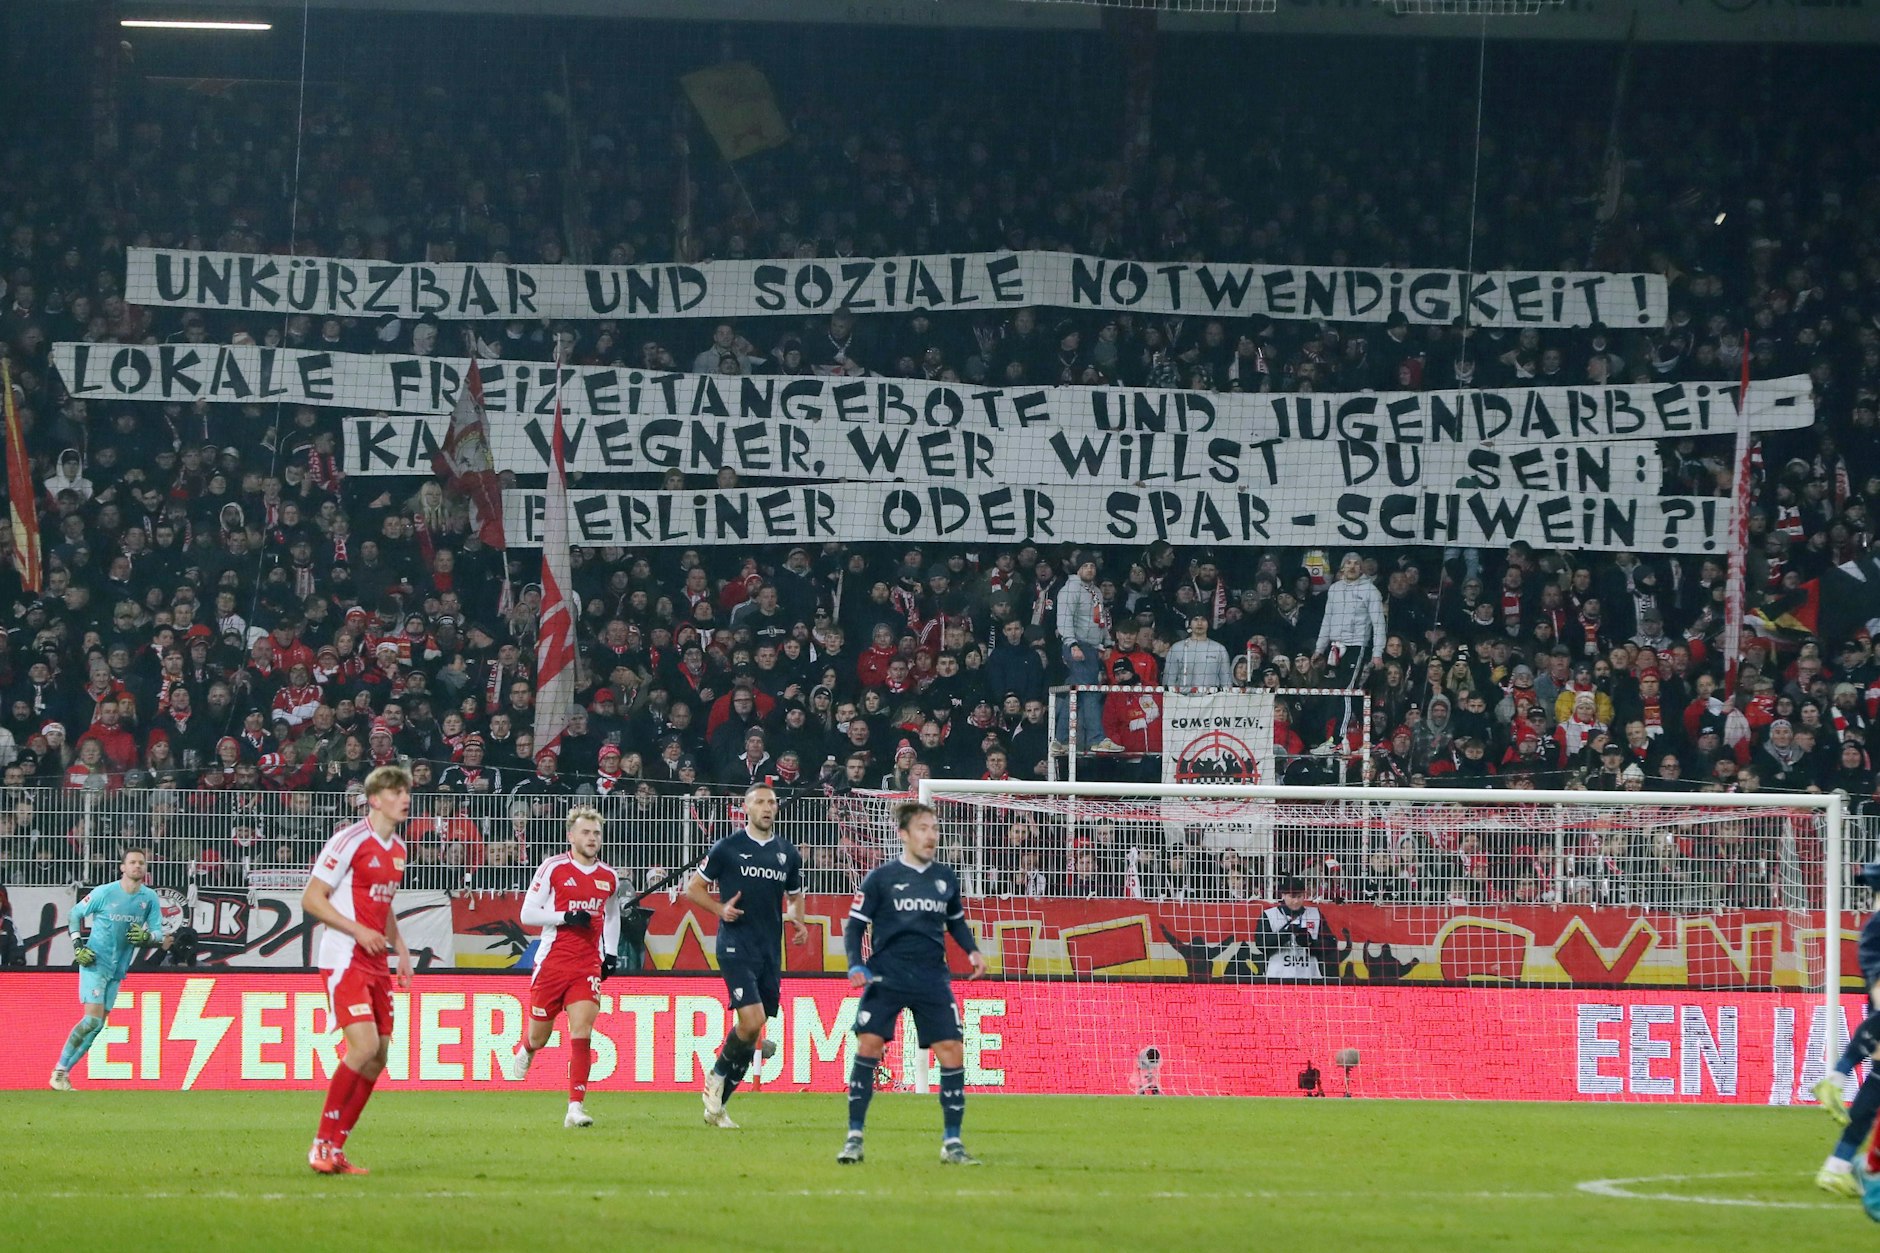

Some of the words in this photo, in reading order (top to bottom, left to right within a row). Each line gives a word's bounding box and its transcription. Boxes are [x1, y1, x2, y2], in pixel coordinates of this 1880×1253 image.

[585, 266, 707, 315] UND
[74, 345, 334, 399] LOKALE
[1092, 391, 1216, 433] UND
[357, 419, 444, 472] KA
[524, 416, 825, 475] WEGNER,
[846, 426, 994, 480] WER
[1338, 440, 1421, 487] DU
[882, 487, 1055, 537] ODER
[1171, 717, 1210, 729] COME
[1214, 716, 1231, 728] ON
